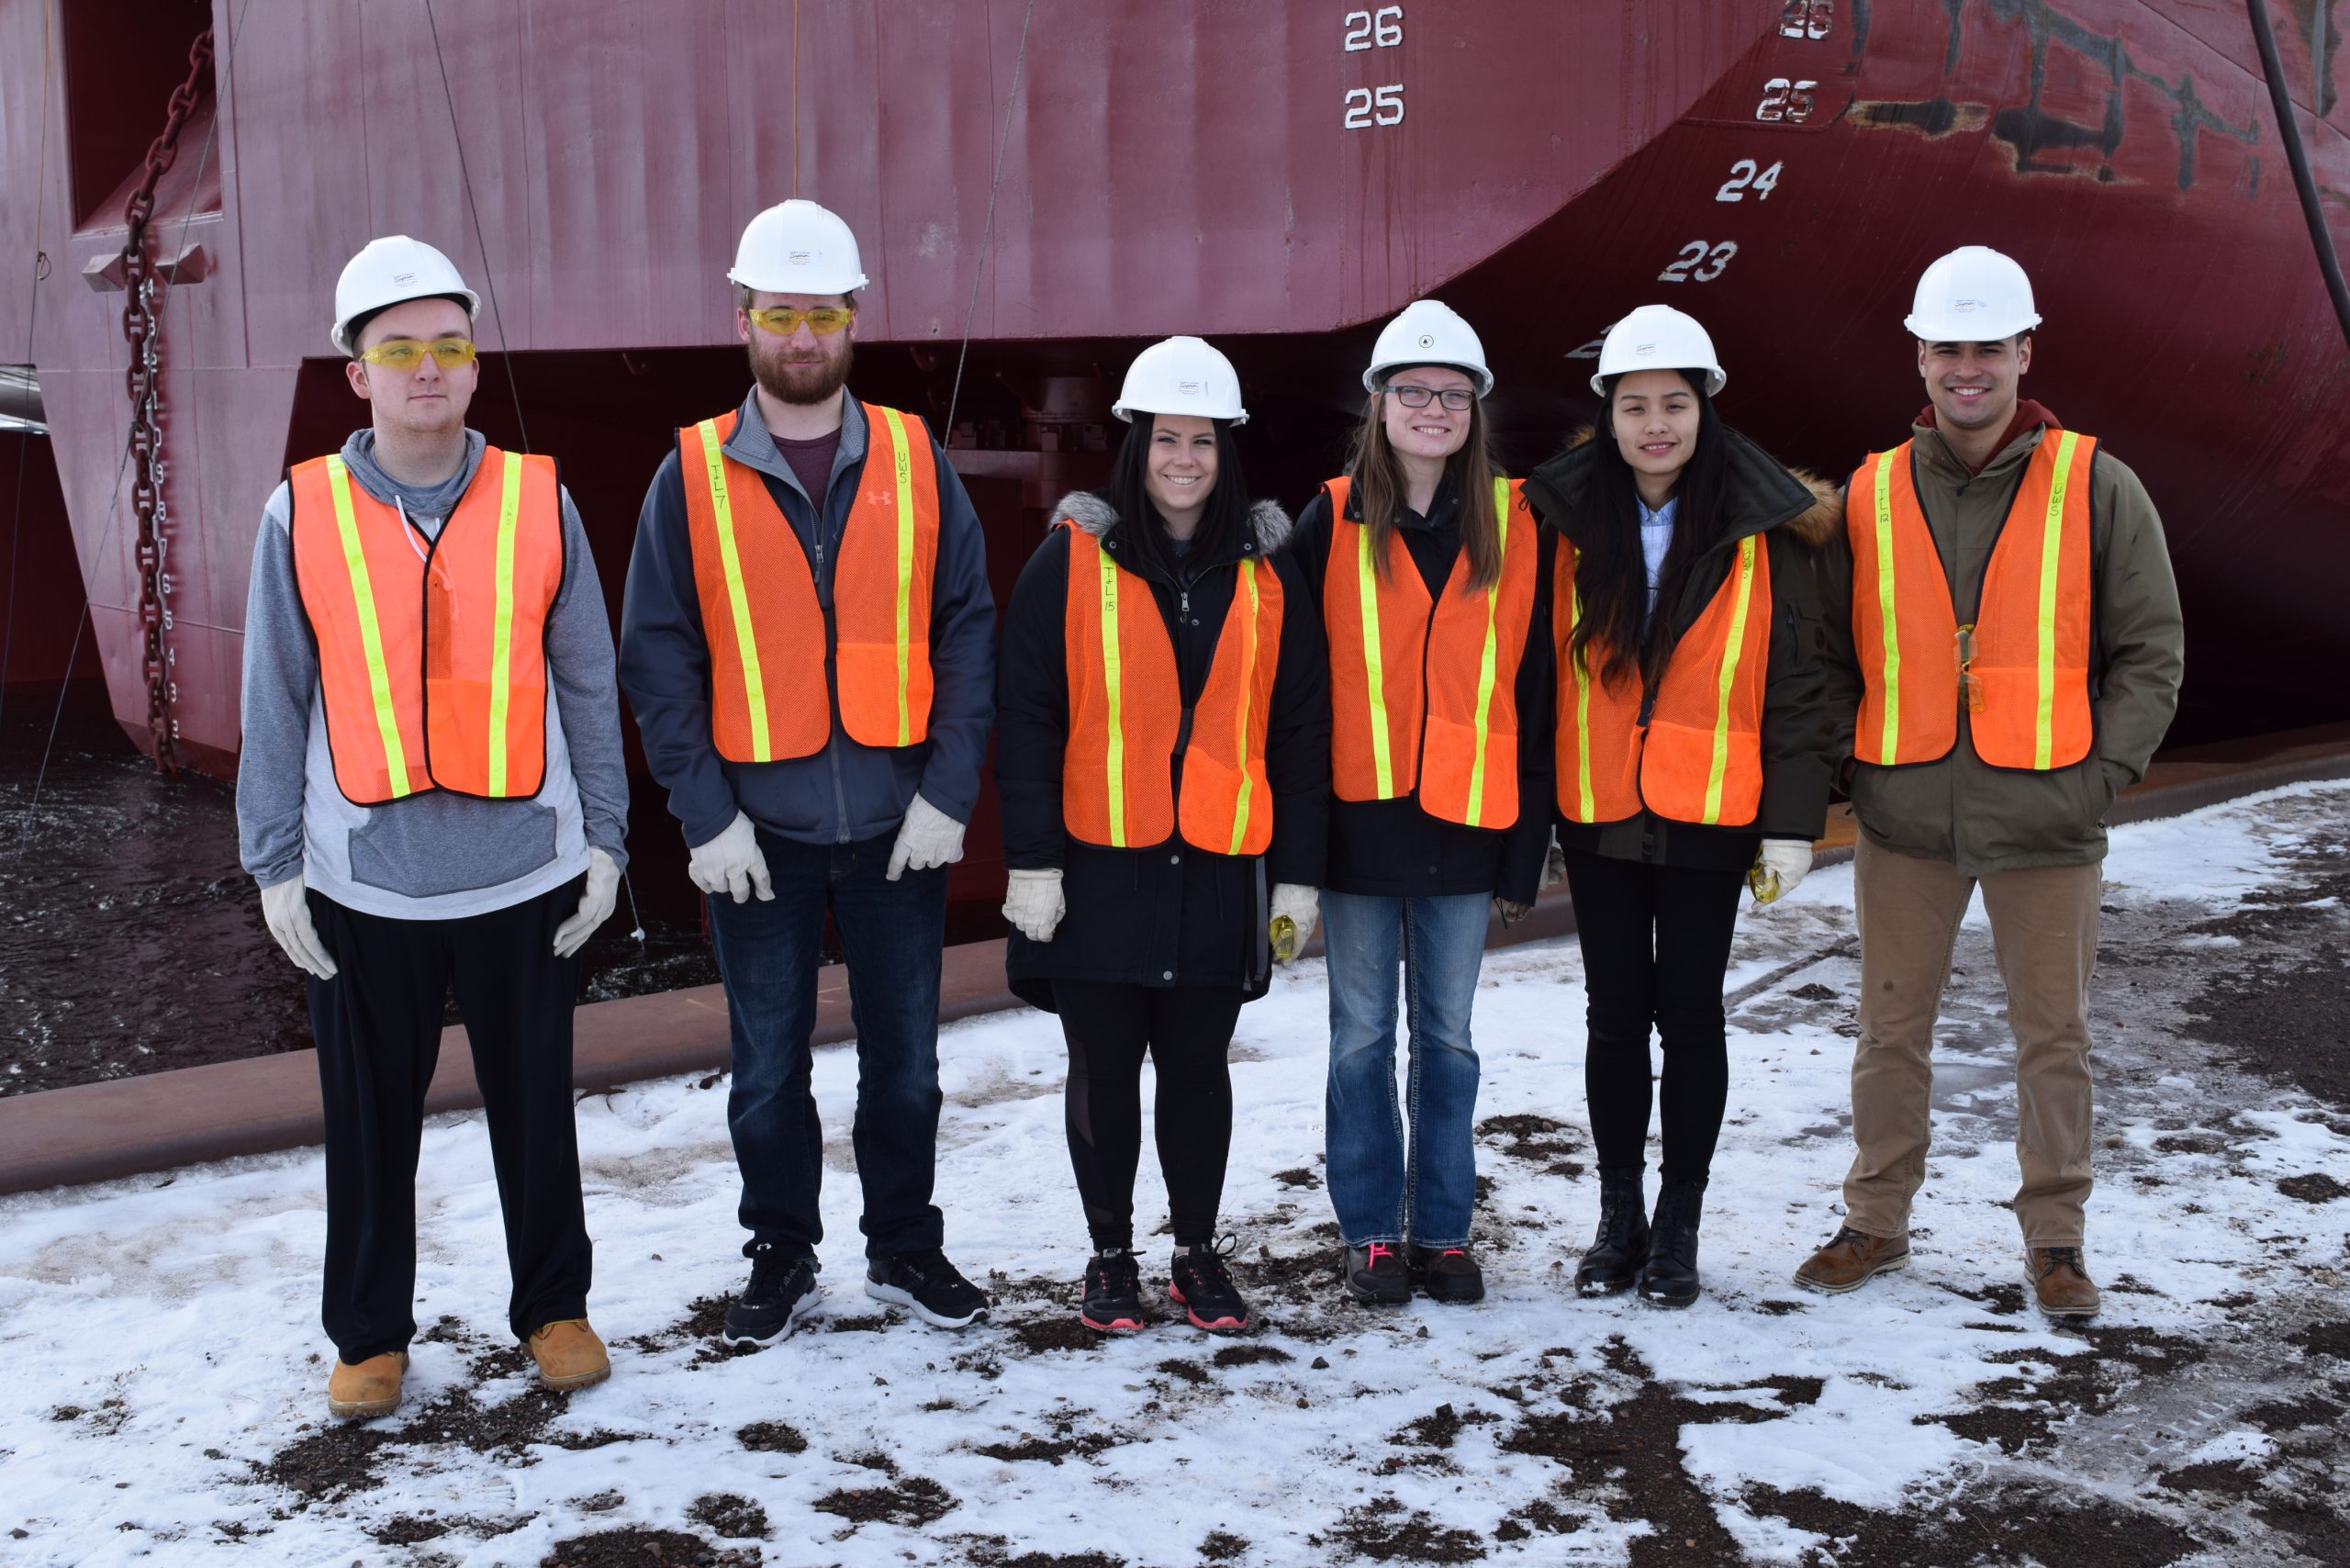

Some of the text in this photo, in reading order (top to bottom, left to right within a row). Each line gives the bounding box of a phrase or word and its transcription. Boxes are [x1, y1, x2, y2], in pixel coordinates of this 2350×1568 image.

[1345, 6, 1403, 51] 26
[1345, 84, 1404, 129] 25
[1756, 78, 1818, 122] 25
[1715, 159, 1784, 201] 24
[1657, 241, 1738, 283] 23
